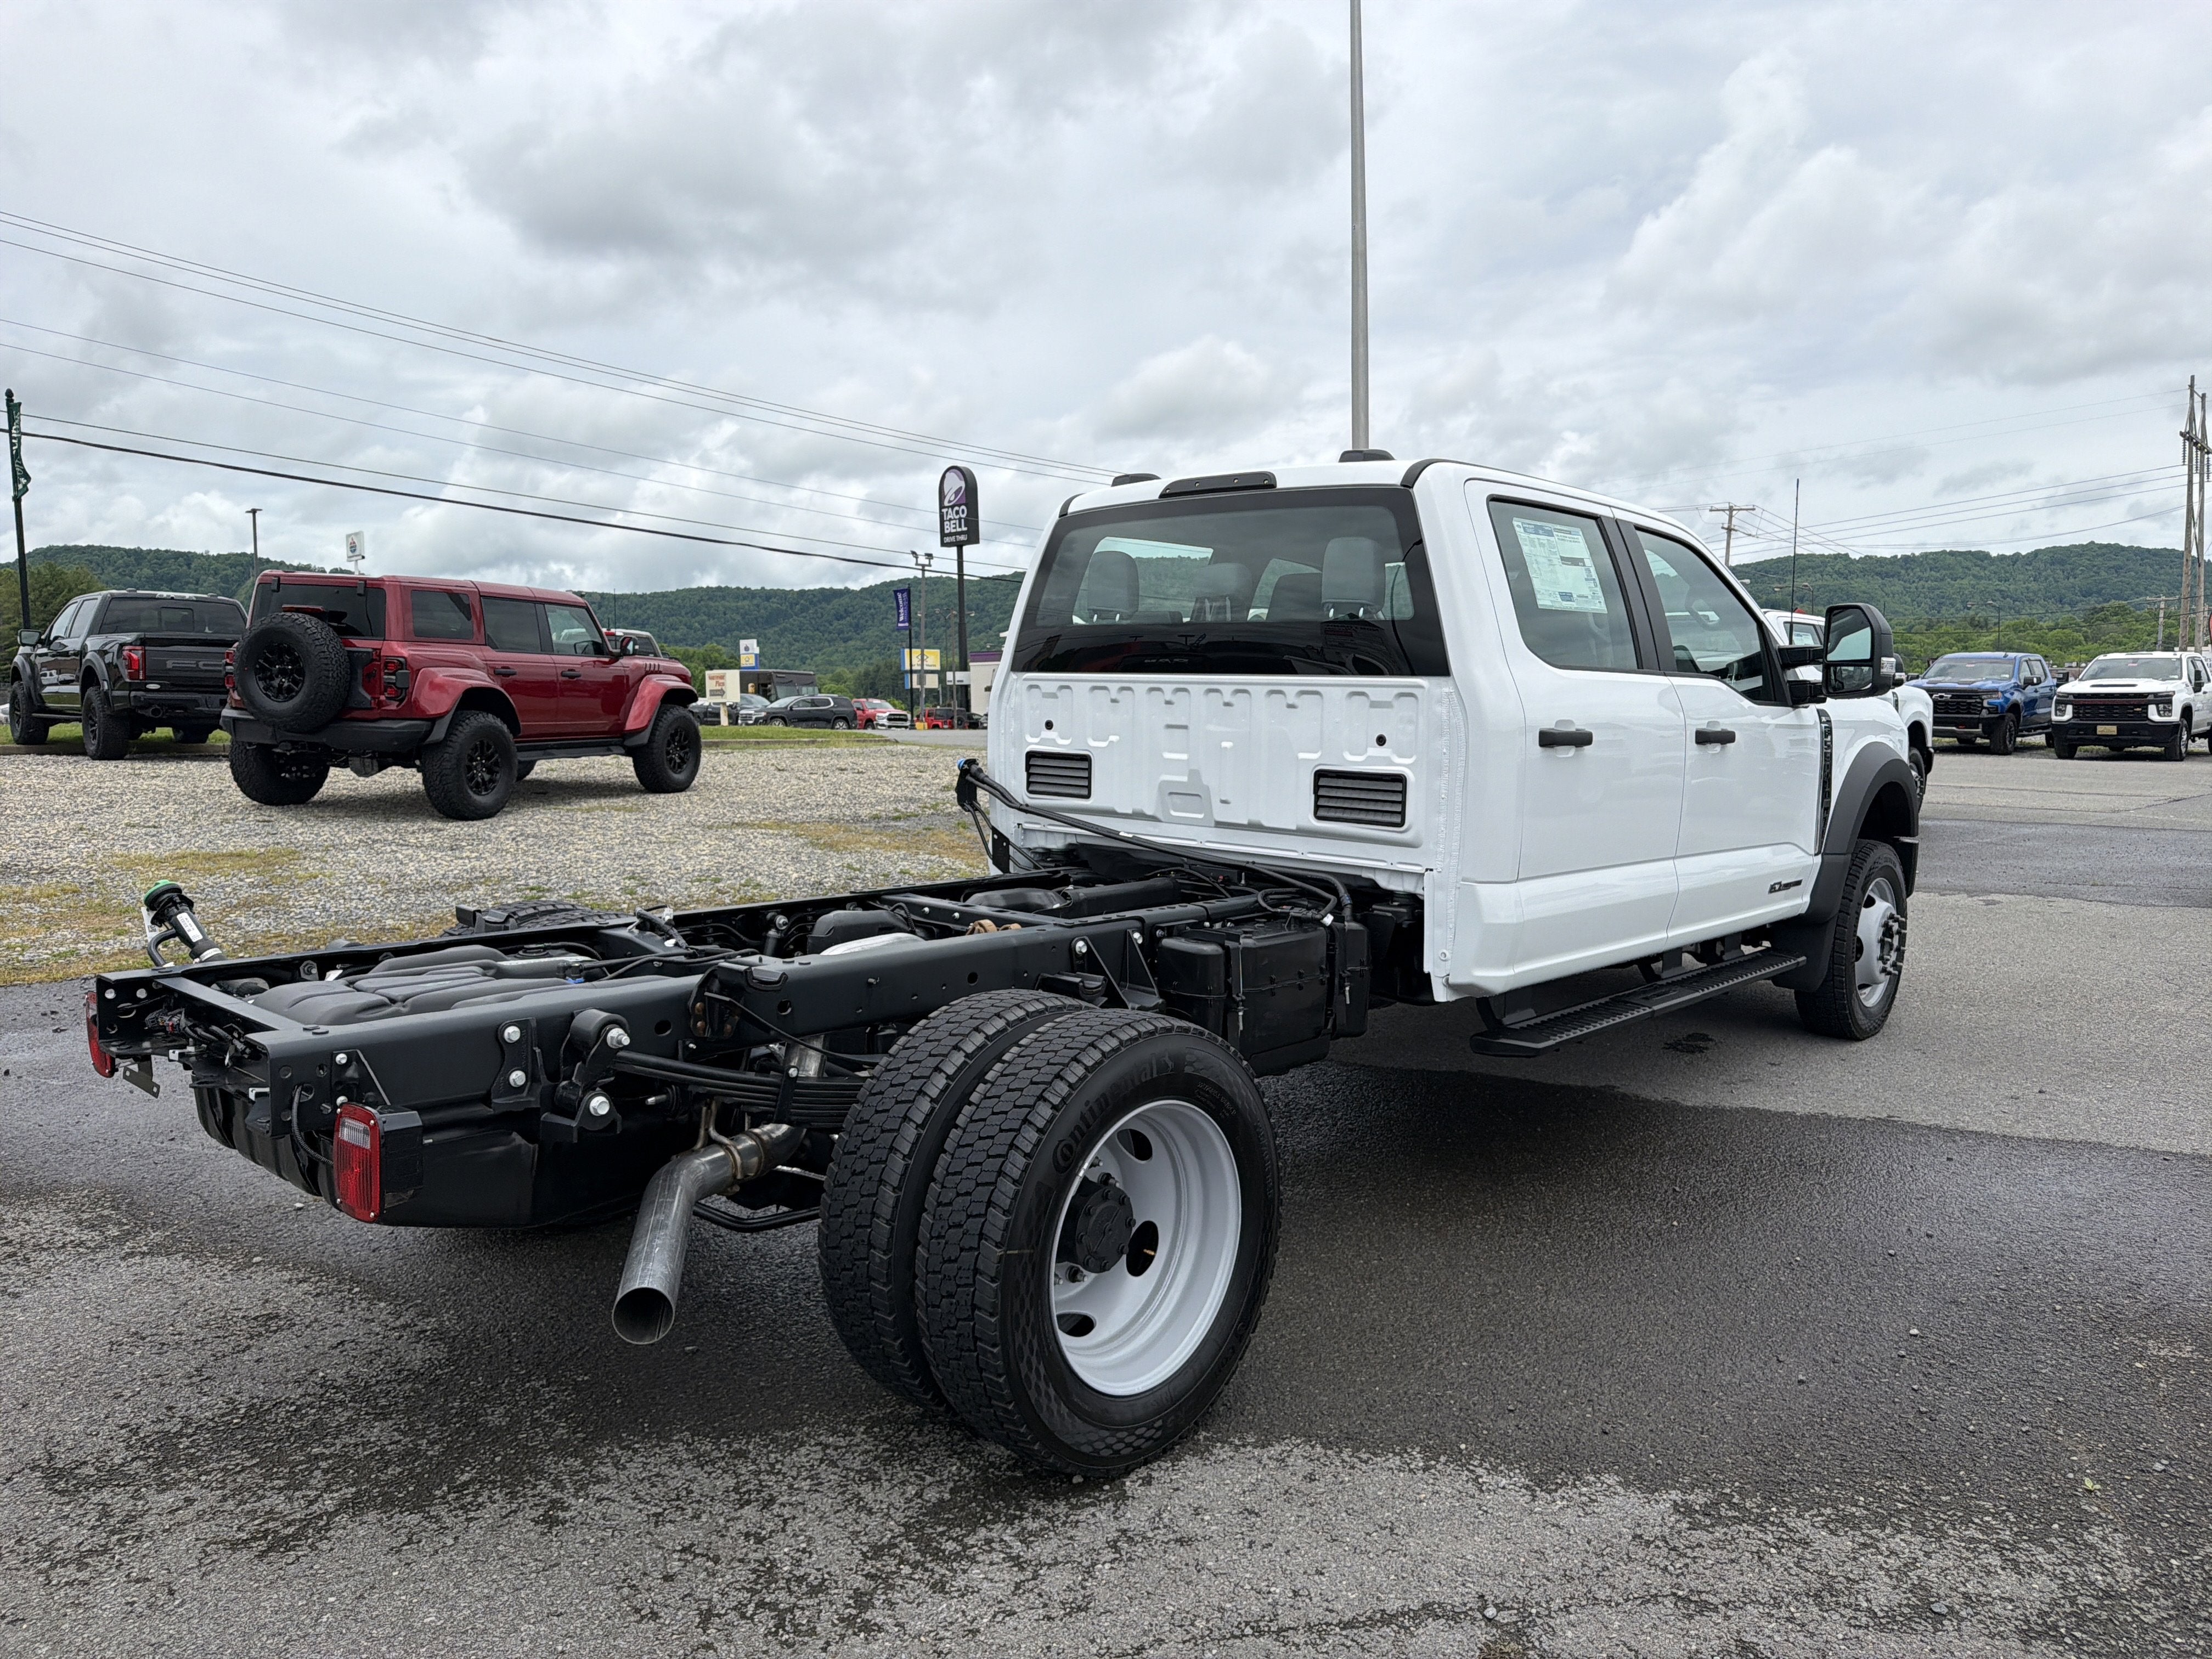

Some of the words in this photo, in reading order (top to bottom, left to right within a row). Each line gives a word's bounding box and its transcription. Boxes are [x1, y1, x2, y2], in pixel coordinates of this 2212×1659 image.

[941, 505, 967, 521] TACO
[944, 519, 968, 534] BELL
[944, 535, 956, 544] DRIVE
[1052, 1052, 1158, 1175] Continental
